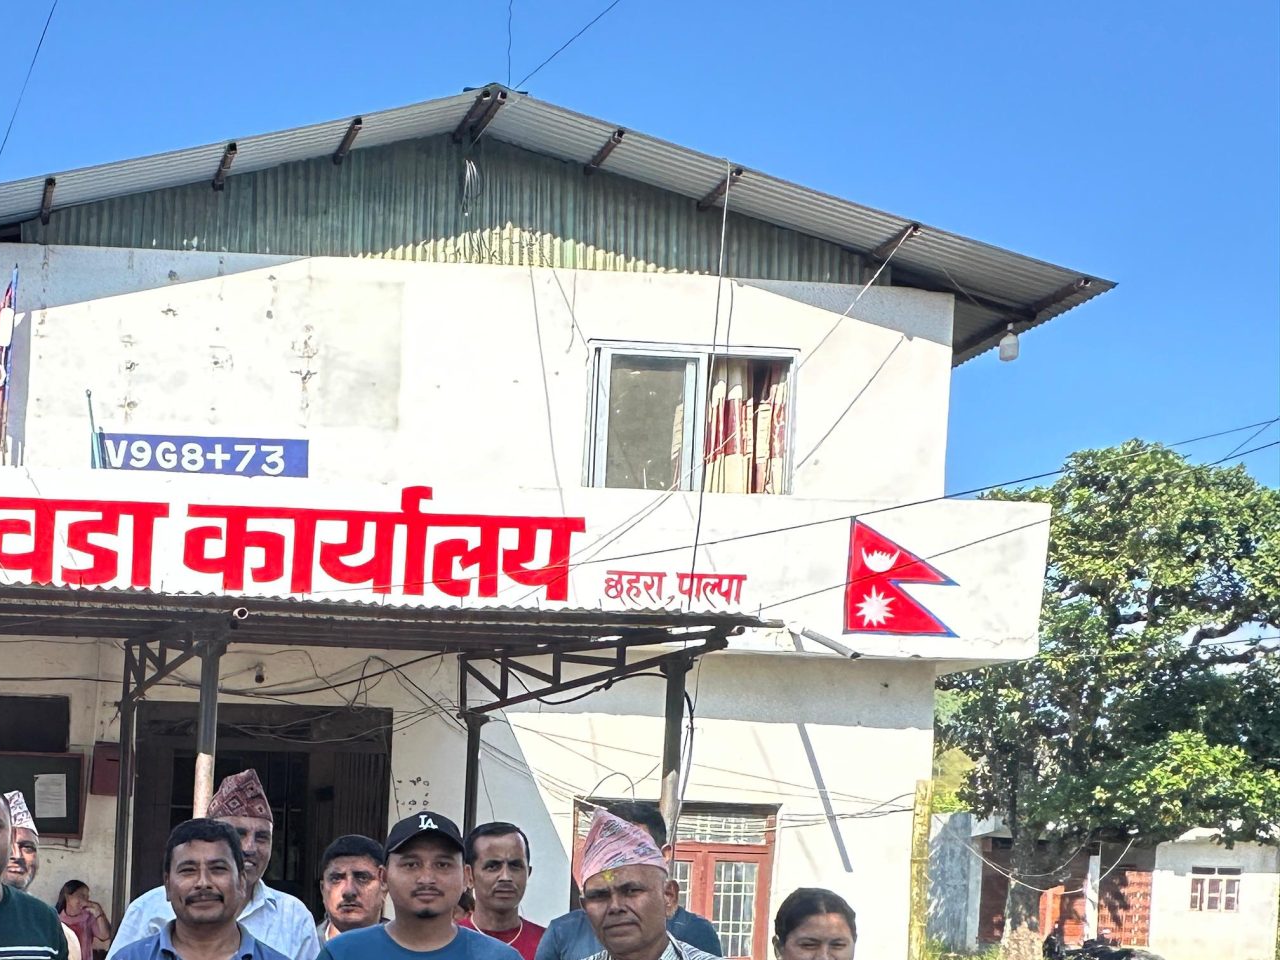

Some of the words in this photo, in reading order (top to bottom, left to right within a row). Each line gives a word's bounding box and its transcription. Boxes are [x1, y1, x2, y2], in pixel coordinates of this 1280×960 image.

[105, 439, 285, 476] V9G8+73
[186, 486, 586, 603] कार्यालय
[604, 570, 675, 606] छहरा,
[676, 572, 748, 609] पाल्पा
[418, 814, 439, 829] LA
